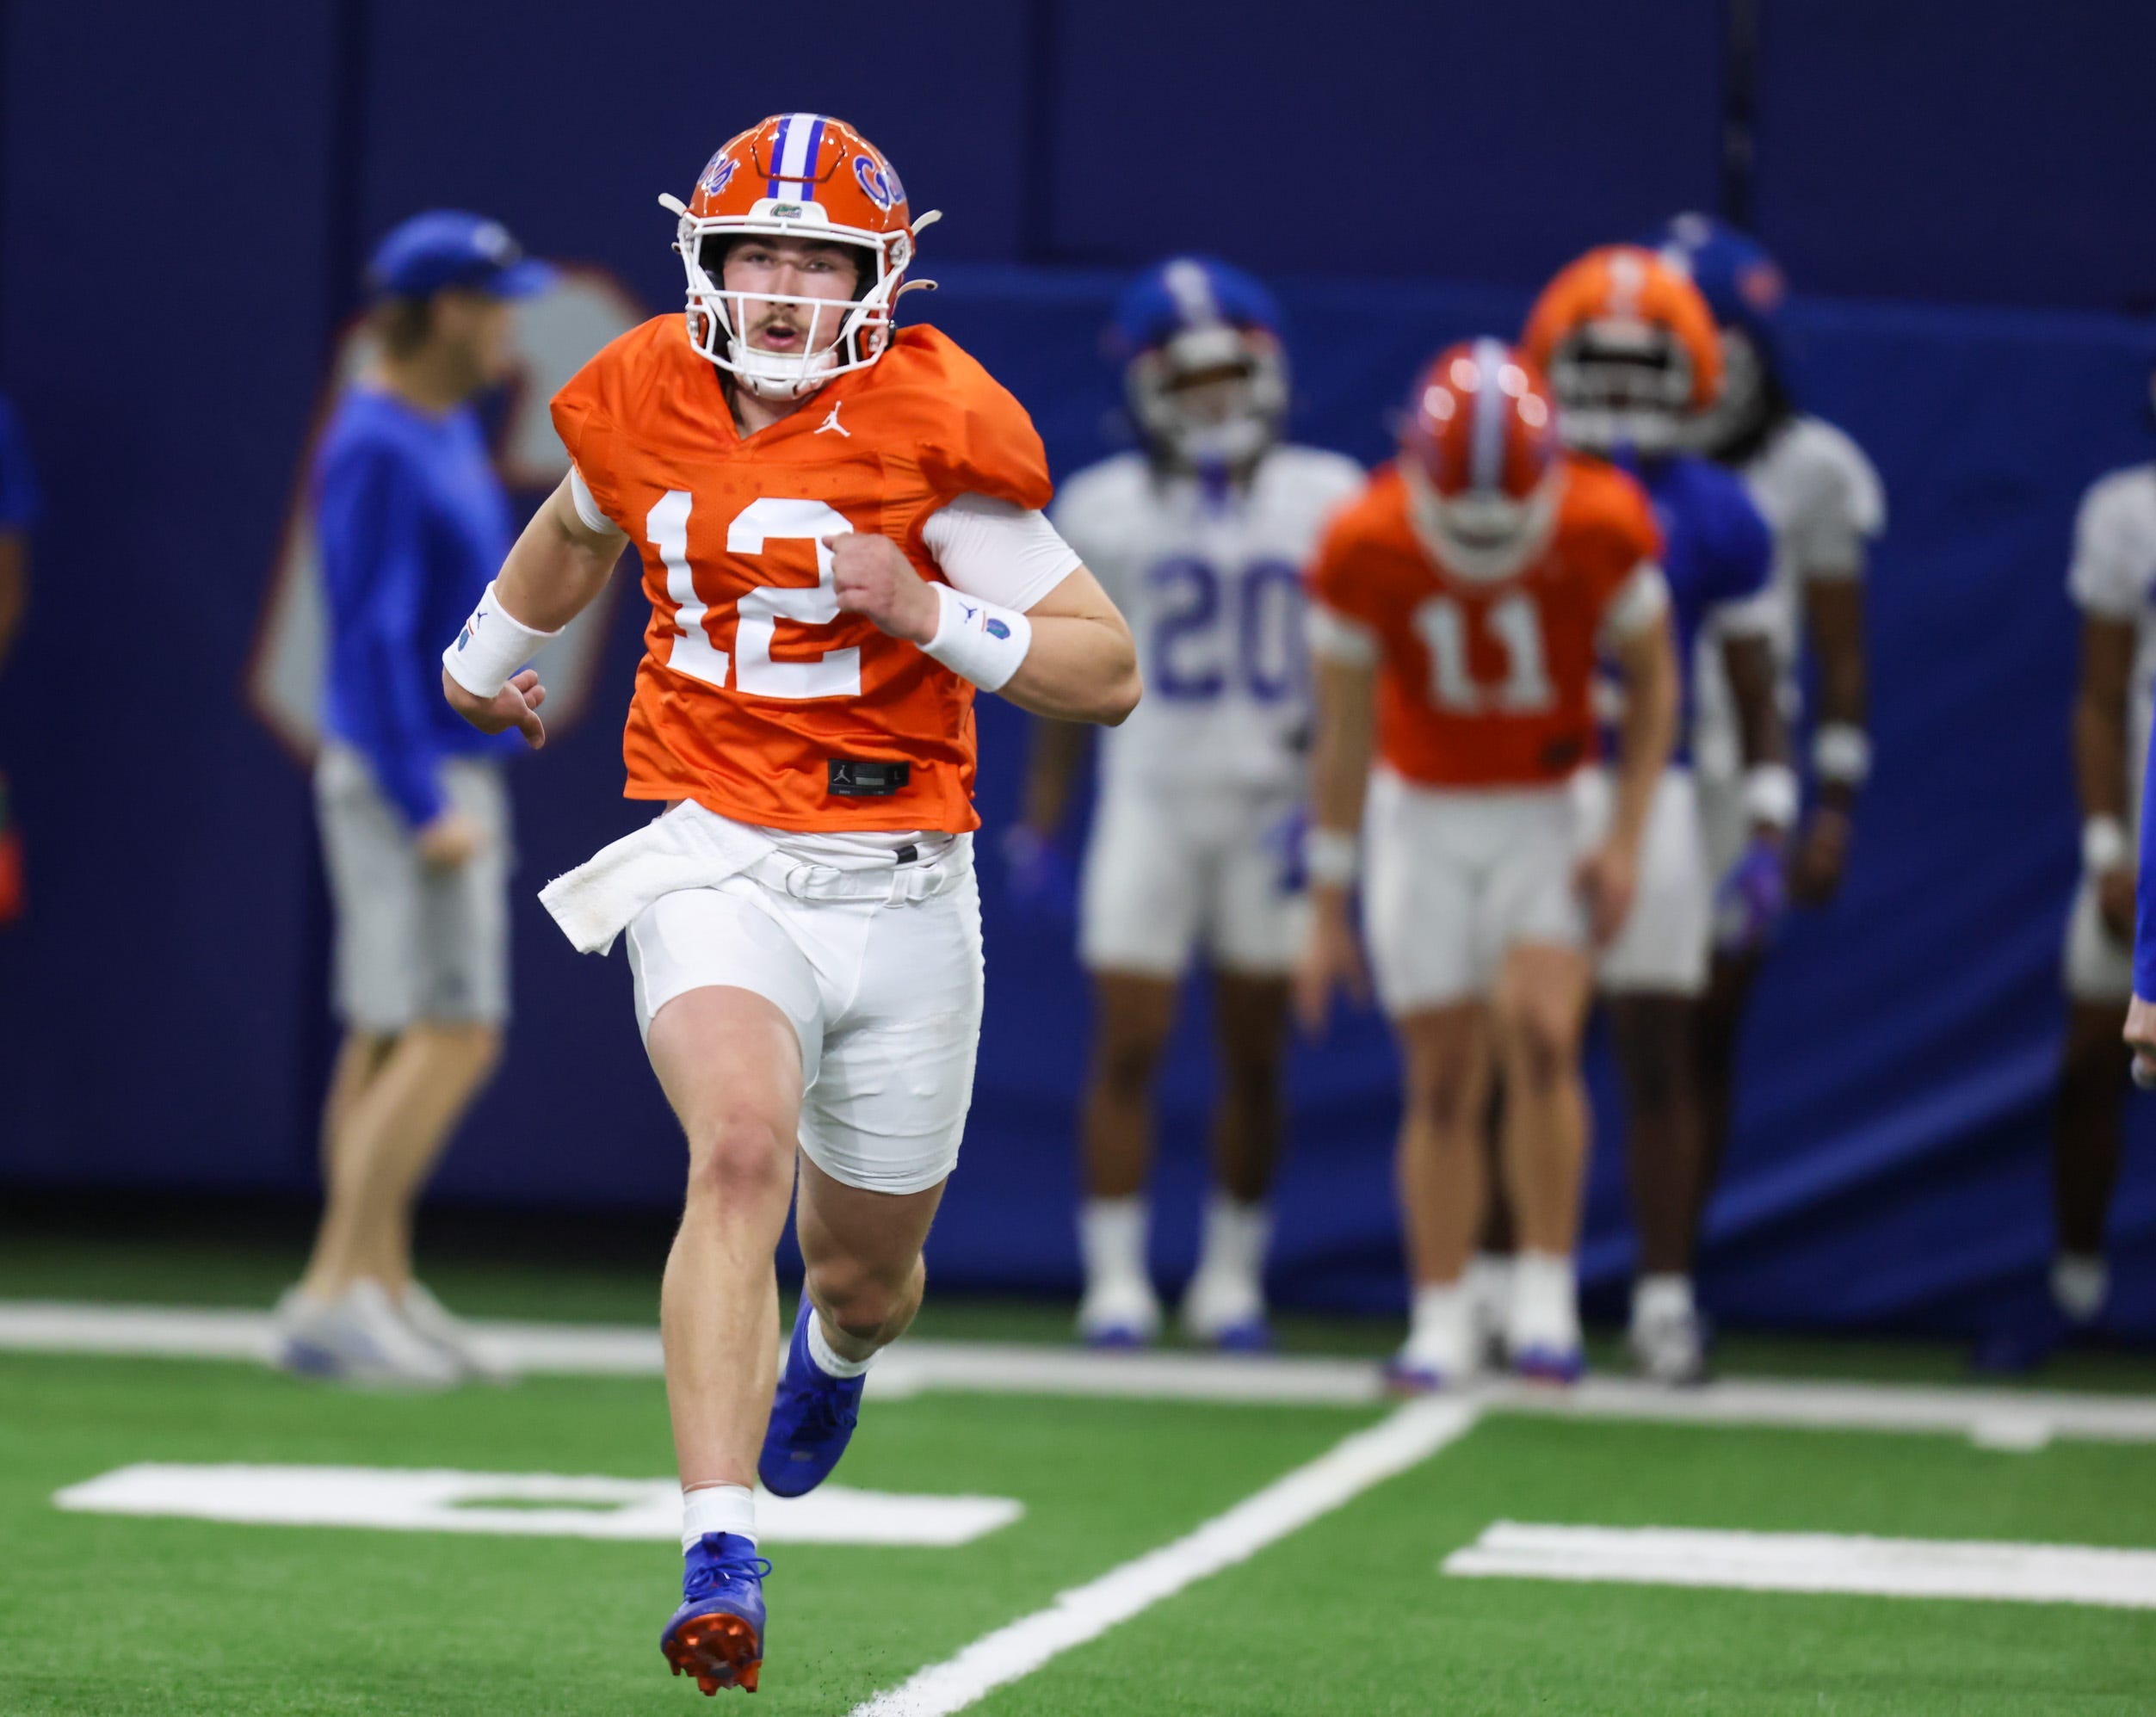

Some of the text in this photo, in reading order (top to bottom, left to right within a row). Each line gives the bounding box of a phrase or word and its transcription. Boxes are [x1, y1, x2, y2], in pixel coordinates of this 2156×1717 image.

[646, 490, 861, 699] 12
[1146, 554, 1313, 704] 20
[1412, 596, 1556, 714] 11
